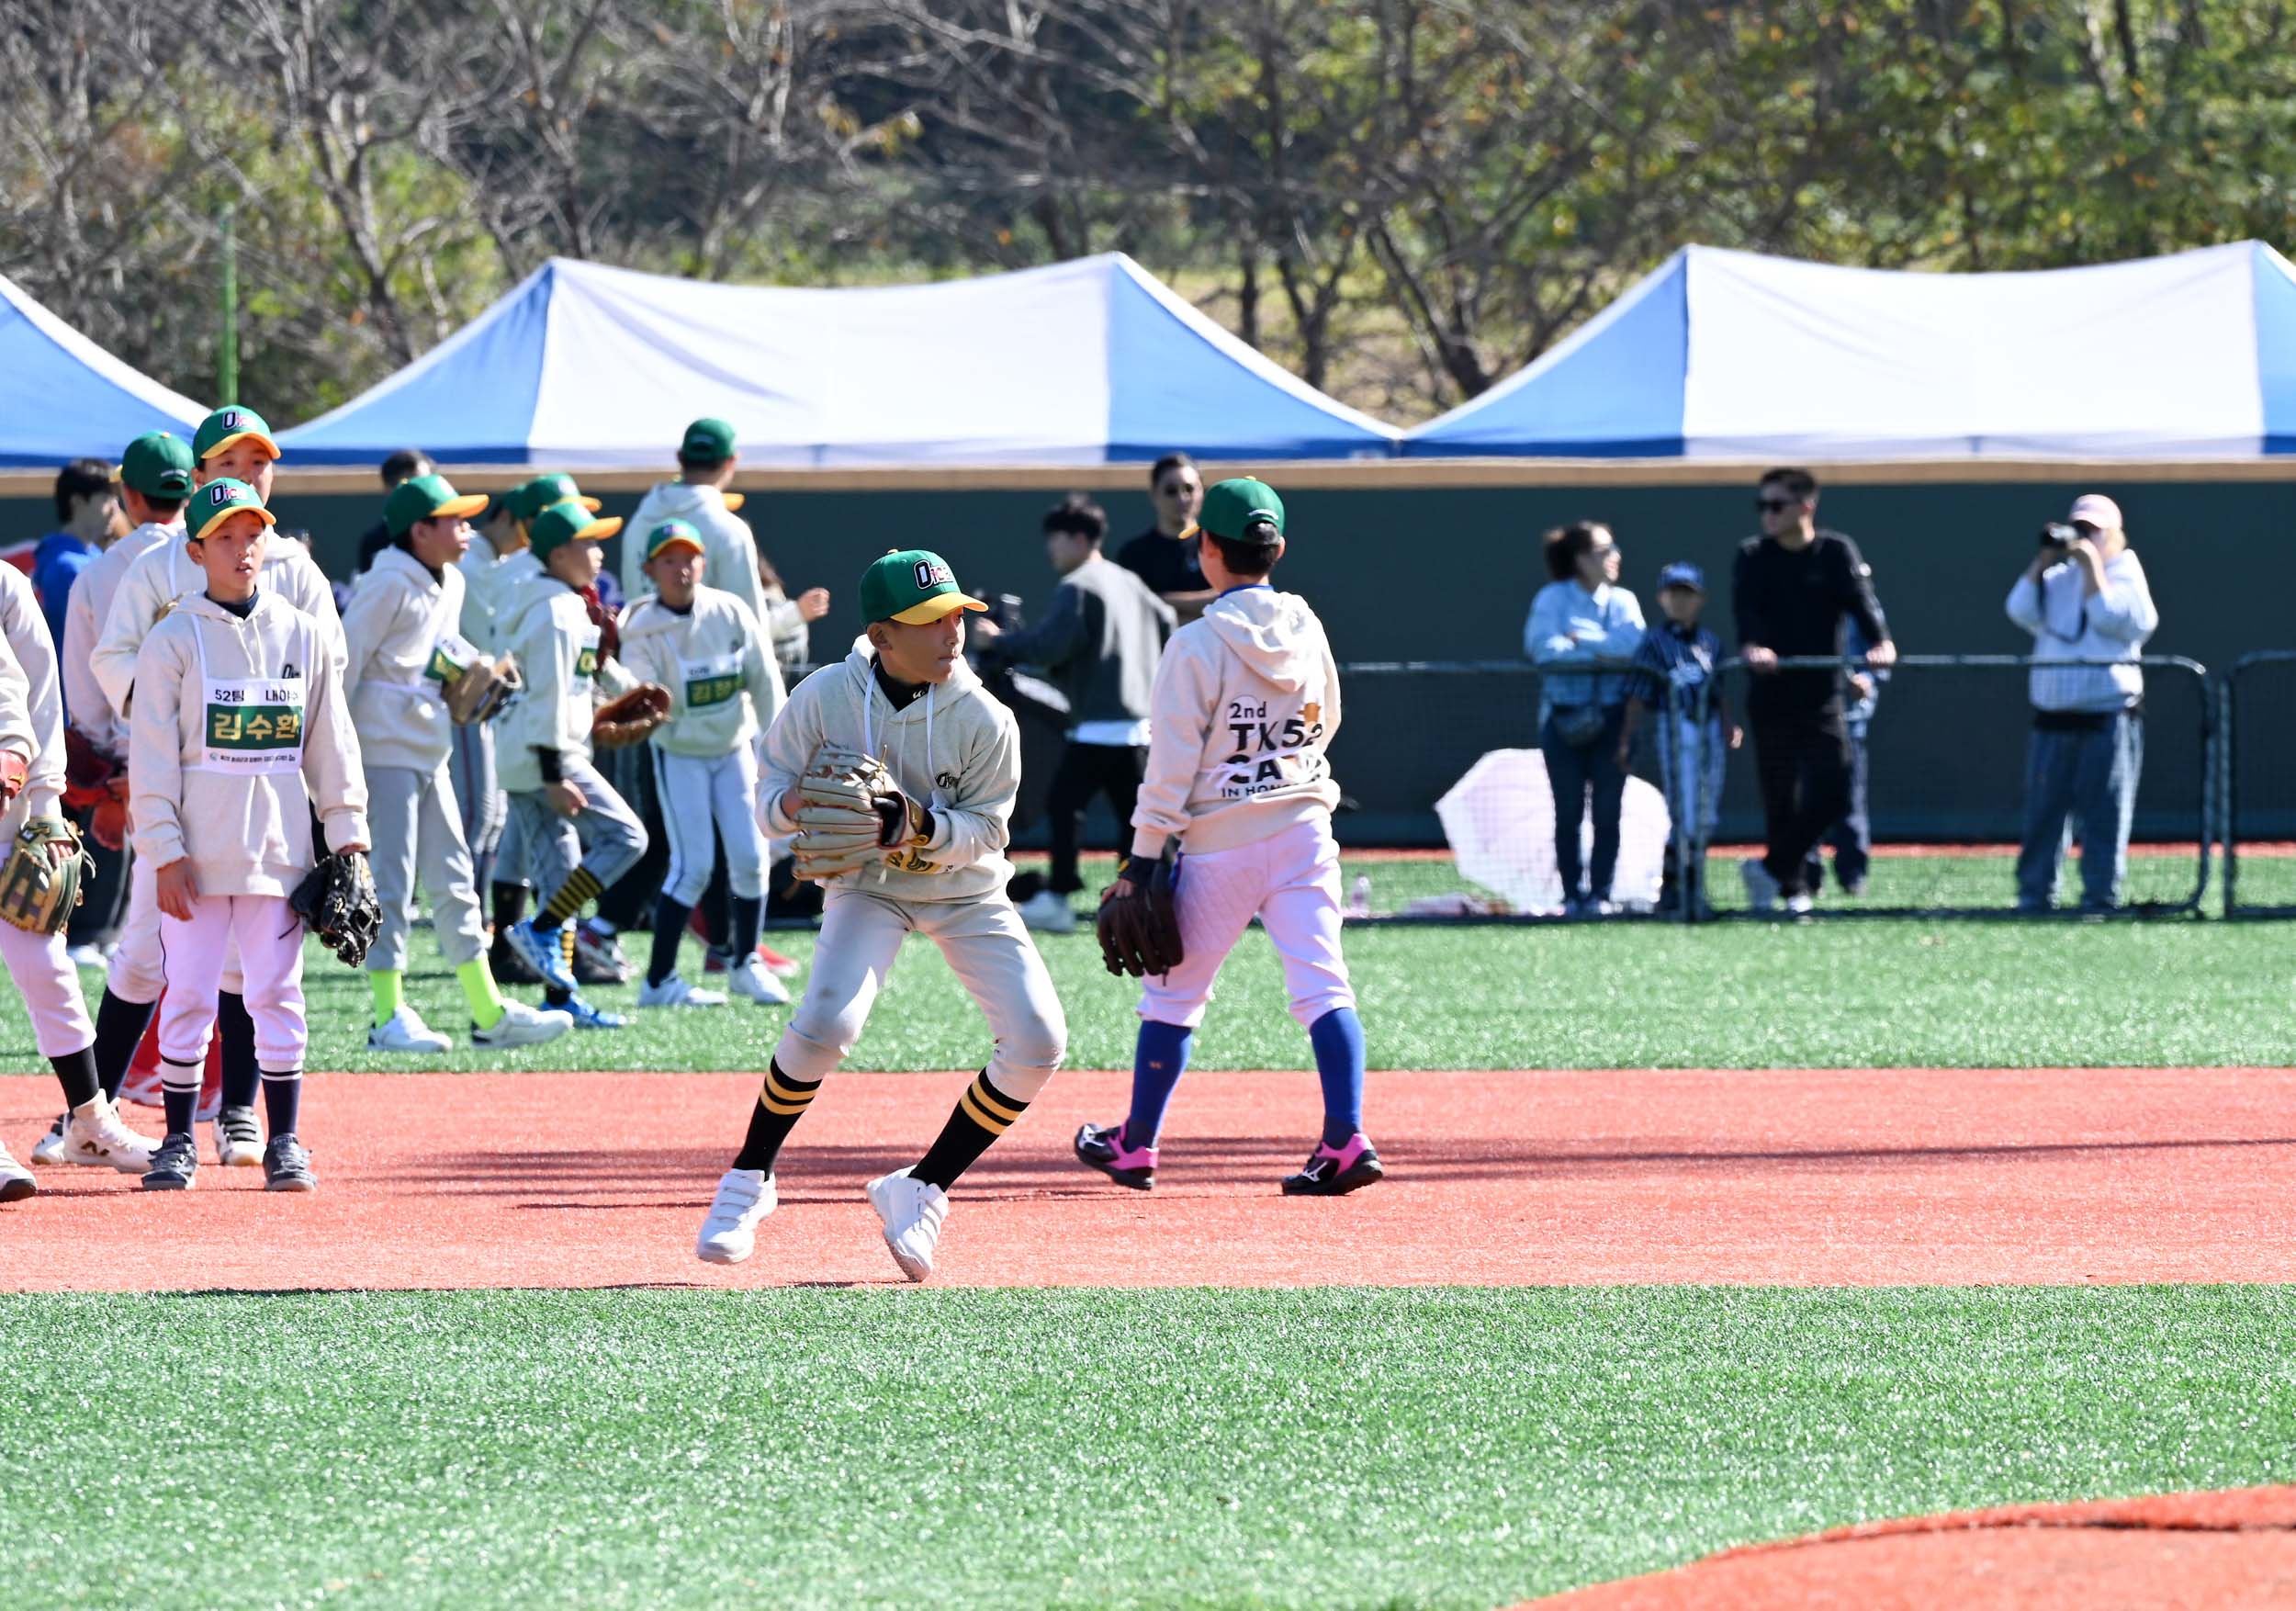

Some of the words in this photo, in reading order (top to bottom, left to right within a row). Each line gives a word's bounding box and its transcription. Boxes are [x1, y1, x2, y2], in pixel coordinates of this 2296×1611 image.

[214, 689, 244, 702] 52팀
[1230, 701, 1266, 718] 2nd
[214, 713, 299, 740] 김수환
[1229, 719, 1322, 751] TK52
[1221, 787, 1239, 798] IN
